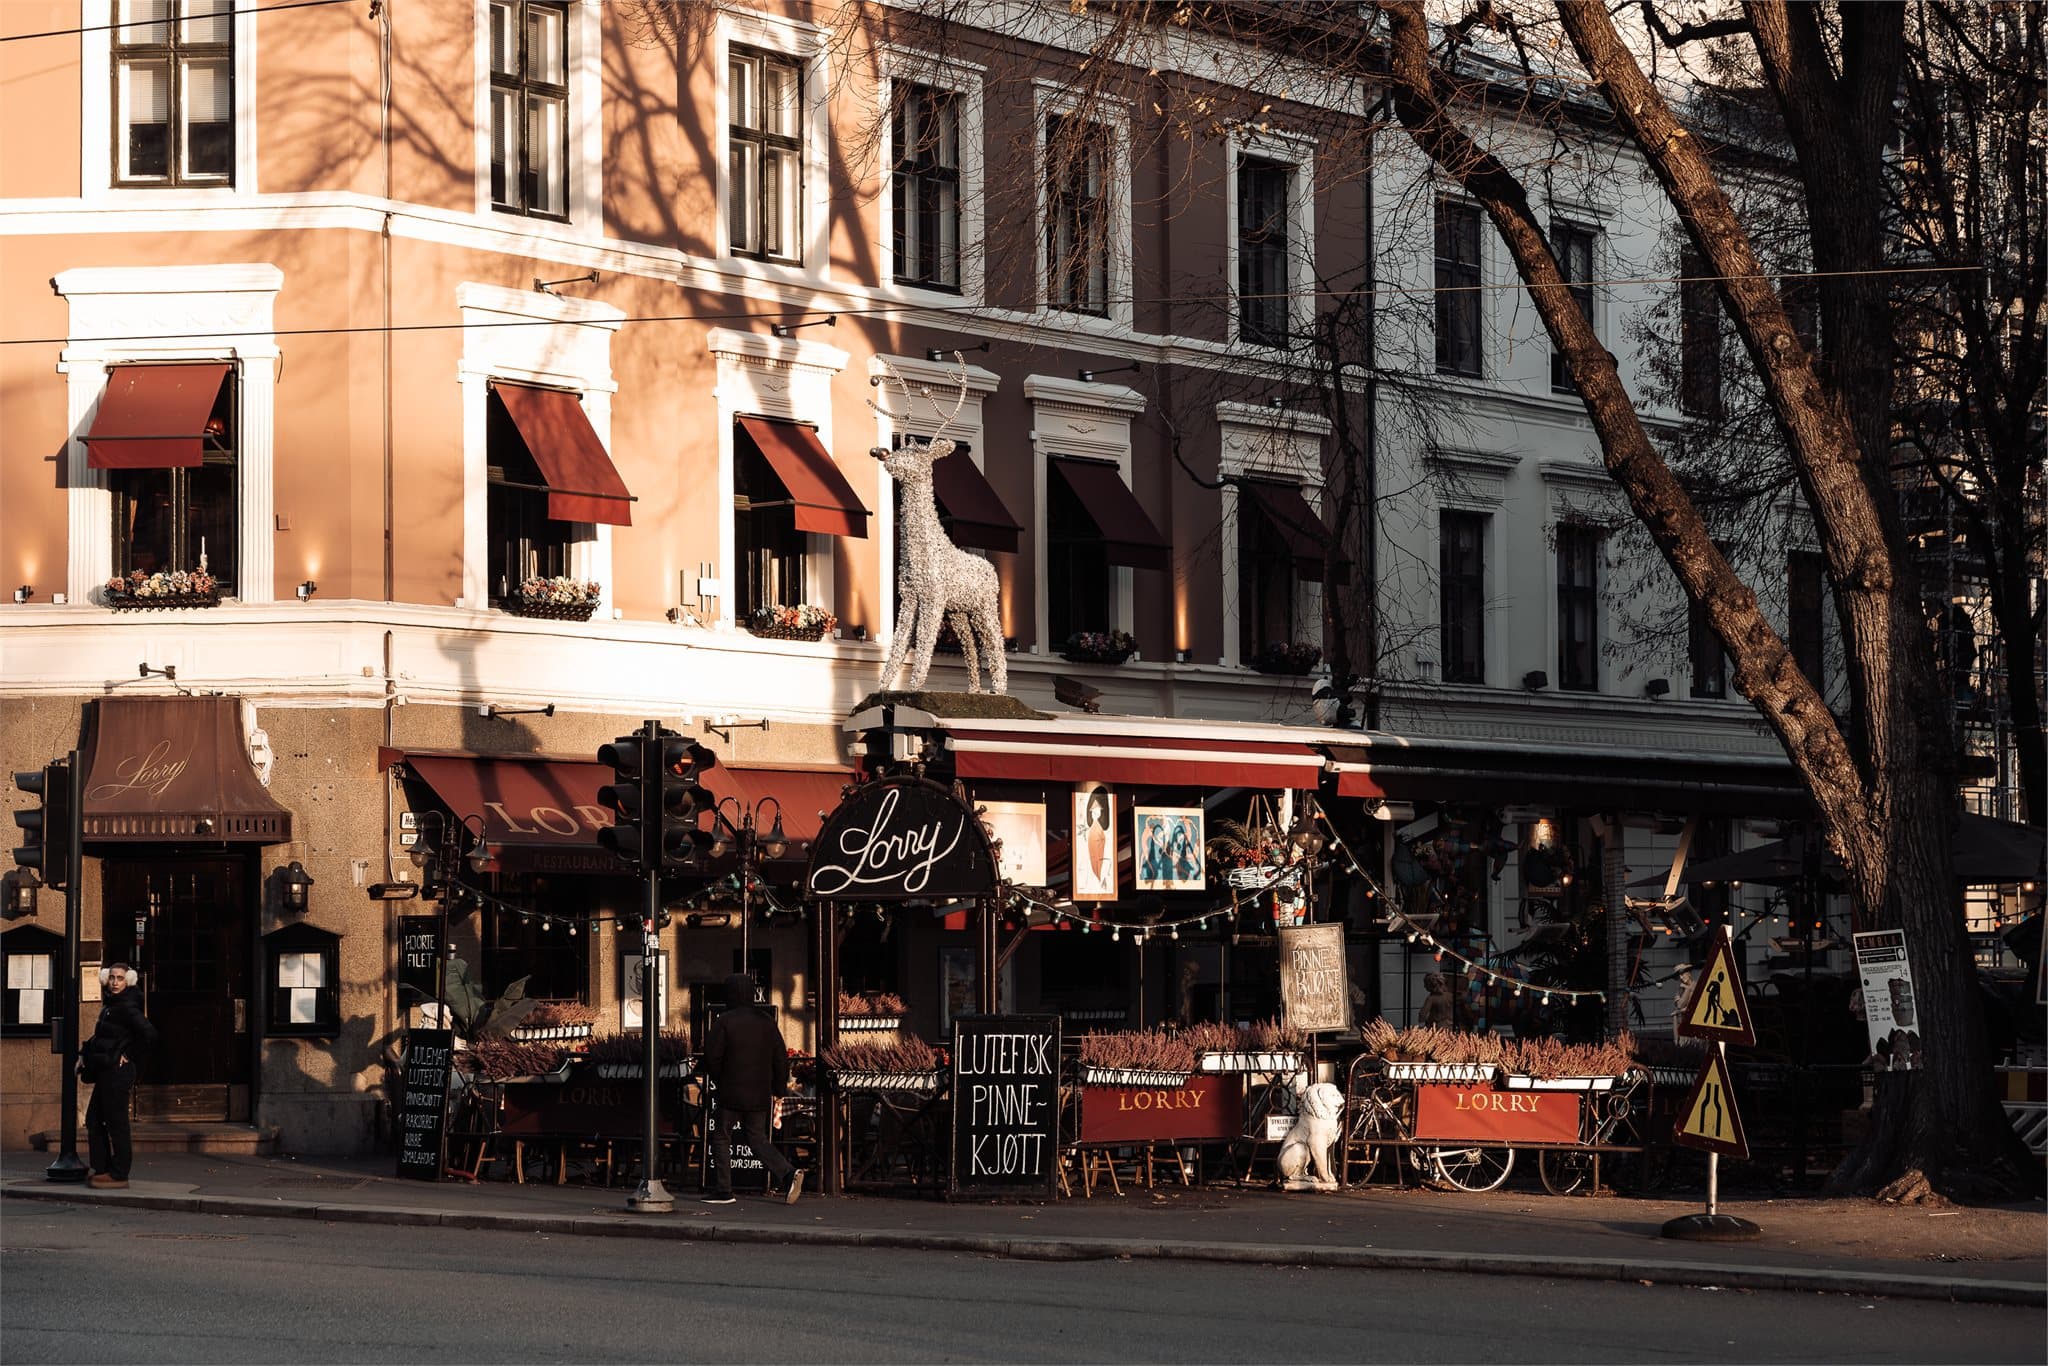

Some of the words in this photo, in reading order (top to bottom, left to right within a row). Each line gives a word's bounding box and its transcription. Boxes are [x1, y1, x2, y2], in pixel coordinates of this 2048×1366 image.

[89, 740, 193, 801] Lorry
[483, 801, 616, 836] LOR
[811, 788, 965, 894] Lorry
[405, 934, 436, 951] HJORTE
[407, 953, 432, 968] FILET
[410, 1045, 449, 1066] JULEMAT
[958, 1034, 1052, 1075] LUTEFISK
[408, 1068, 445, 1087] LUTEFISK
[559, 1087, 625, 1105] LORRY
[1119, 1090, 1205, 1111] LORRY
[1455, 1093, 1541, 1112] LORRY
[971, 1133, 1047, 1176] KJØTT
